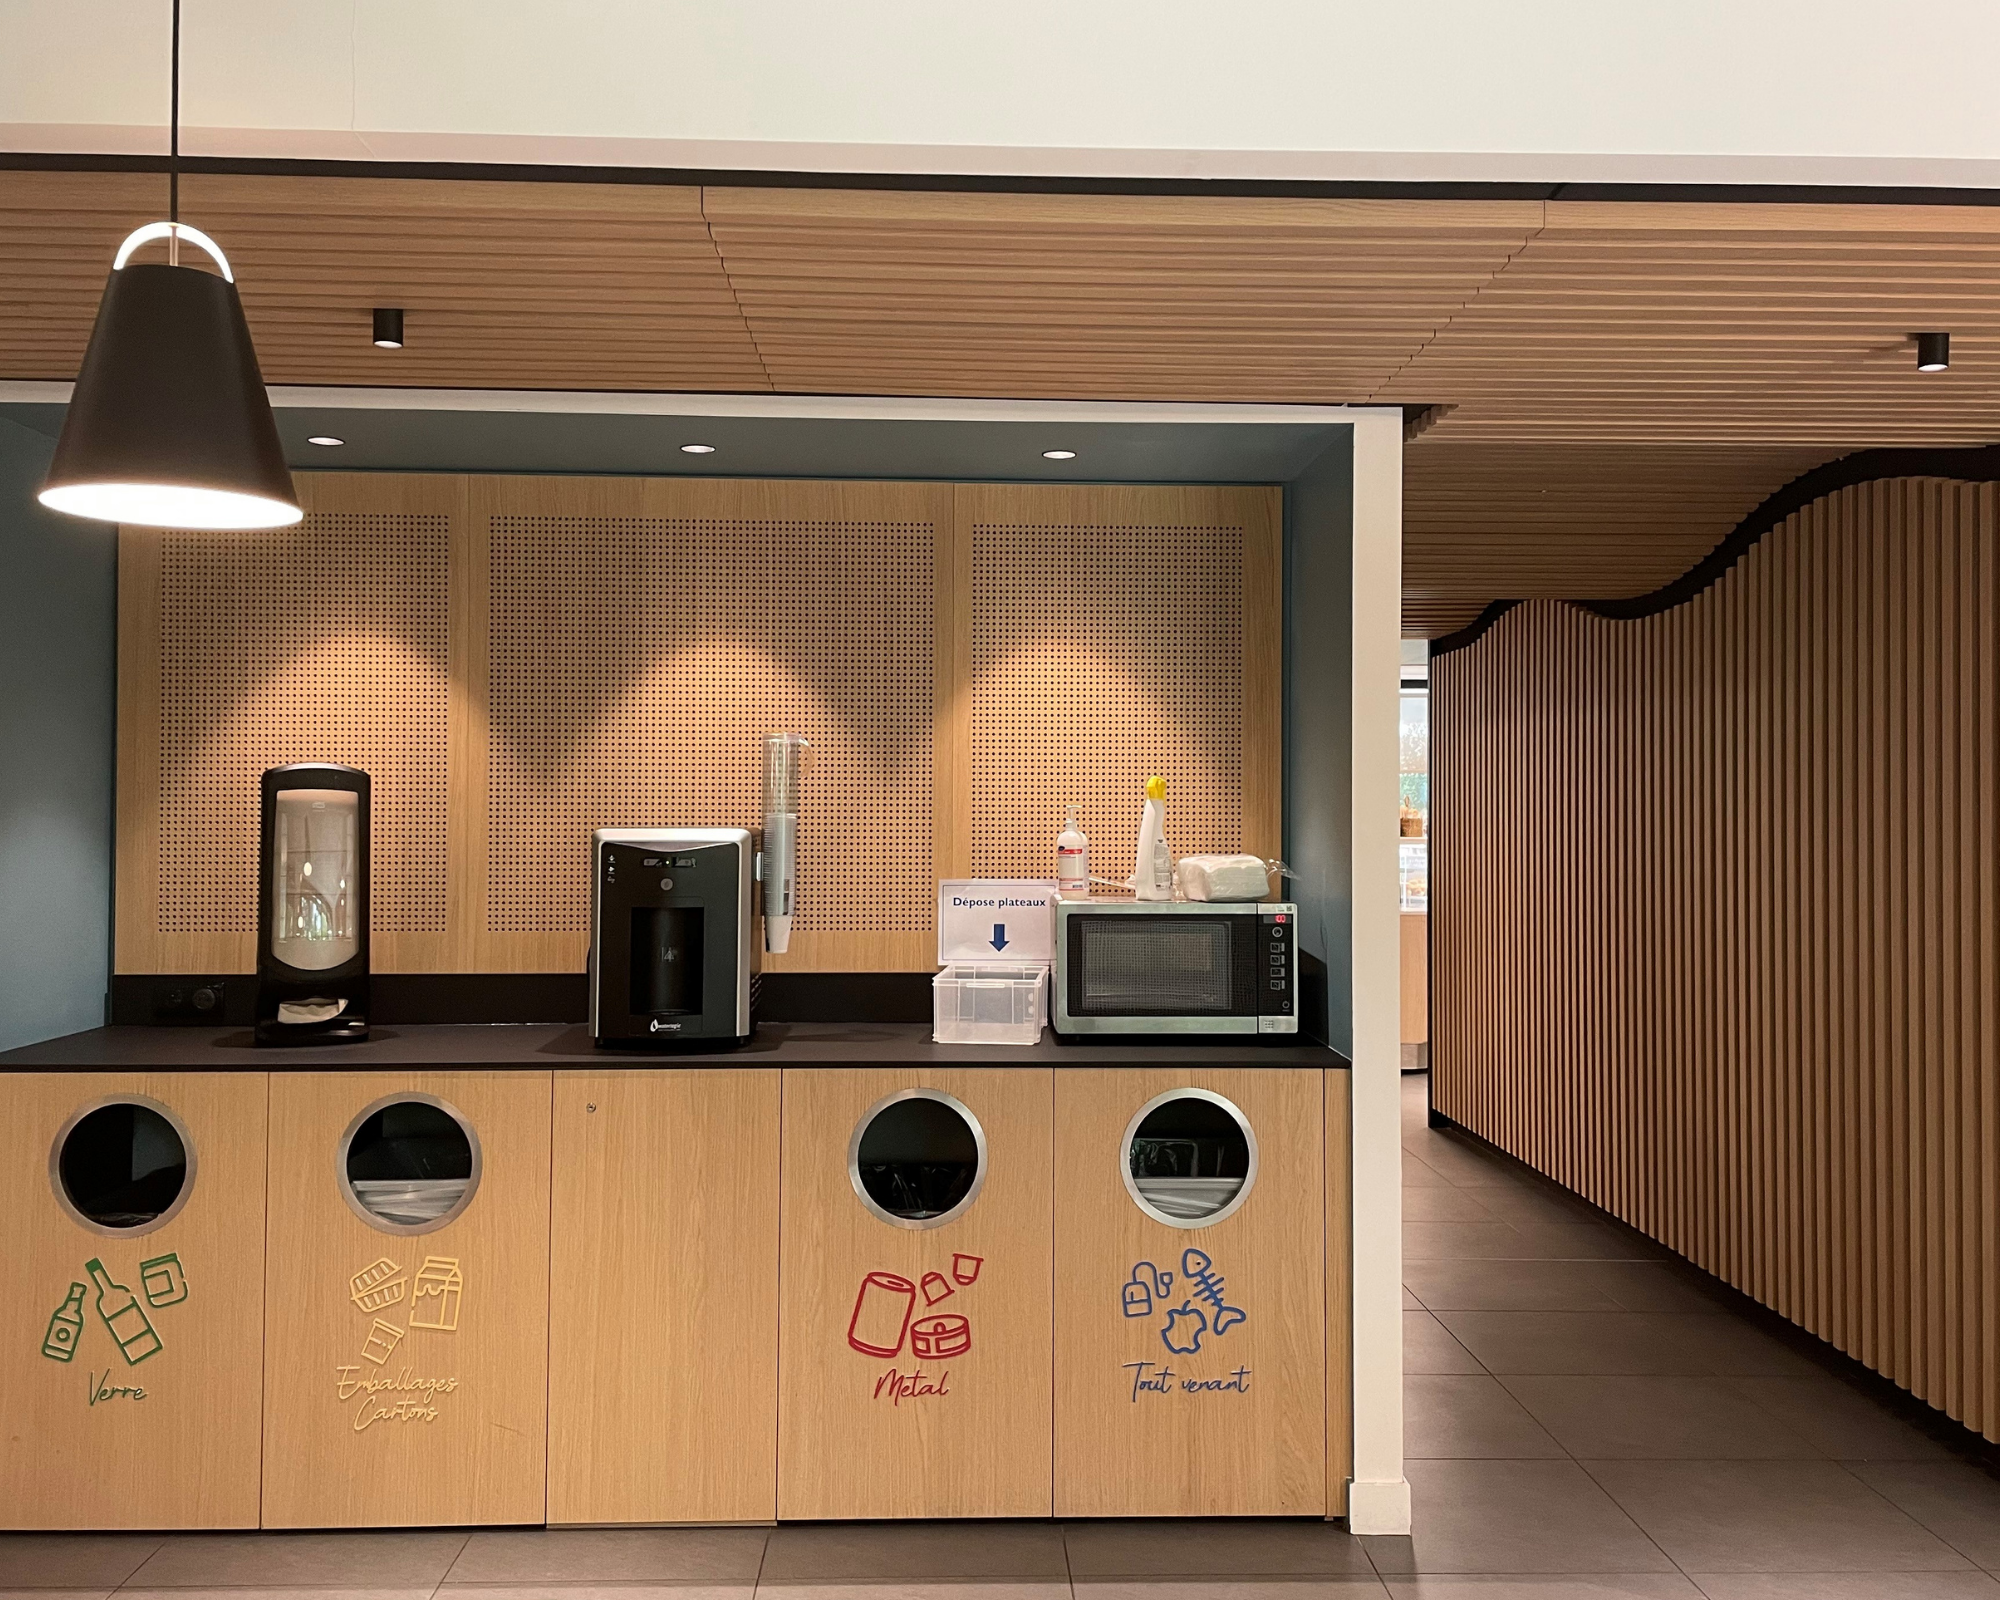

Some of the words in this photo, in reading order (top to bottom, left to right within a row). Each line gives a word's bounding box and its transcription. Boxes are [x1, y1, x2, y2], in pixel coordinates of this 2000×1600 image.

[953, 897, 995, 909] Dépose
[998, 897, 1046, 909] plateaux
[89, 1368, 148, 1406] Verre
[336, 1365, 459, 1404] Emballages
[873, 1368, 949, 1406] Metal
[1122, 1361, 1176, 1403] Tout
[1181, 1365, 1252, 1393] venant
[353, 1395, 439, 1431] Cartons
